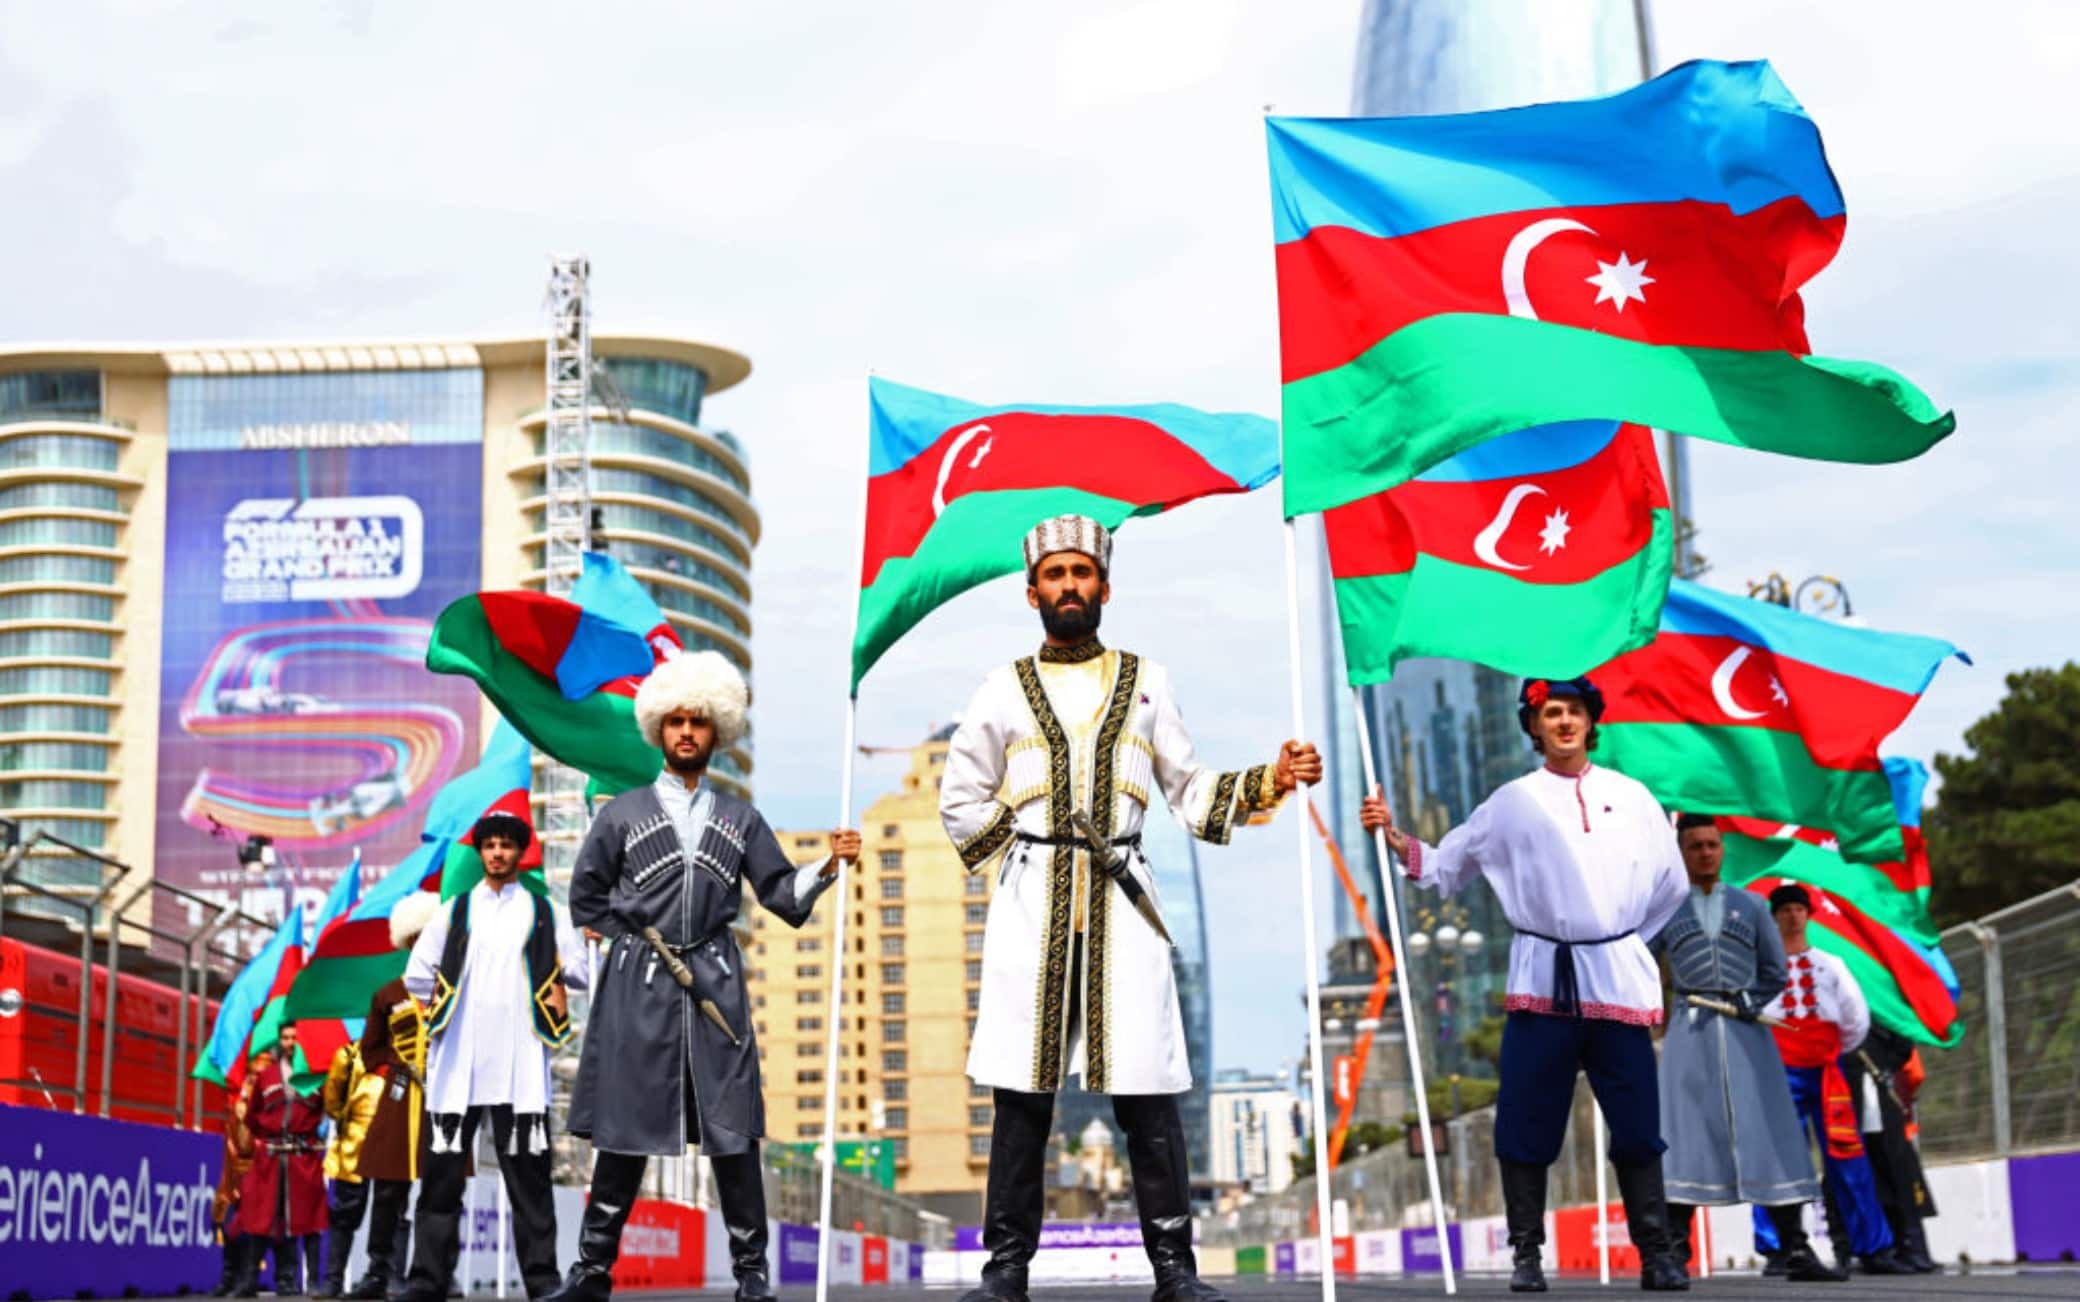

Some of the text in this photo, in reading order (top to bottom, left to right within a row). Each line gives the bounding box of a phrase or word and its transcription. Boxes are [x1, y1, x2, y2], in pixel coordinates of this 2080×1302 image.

[240, 422, 410, 448] ABSHERON
[224, 555, 393, 579] GRAND PRIX
